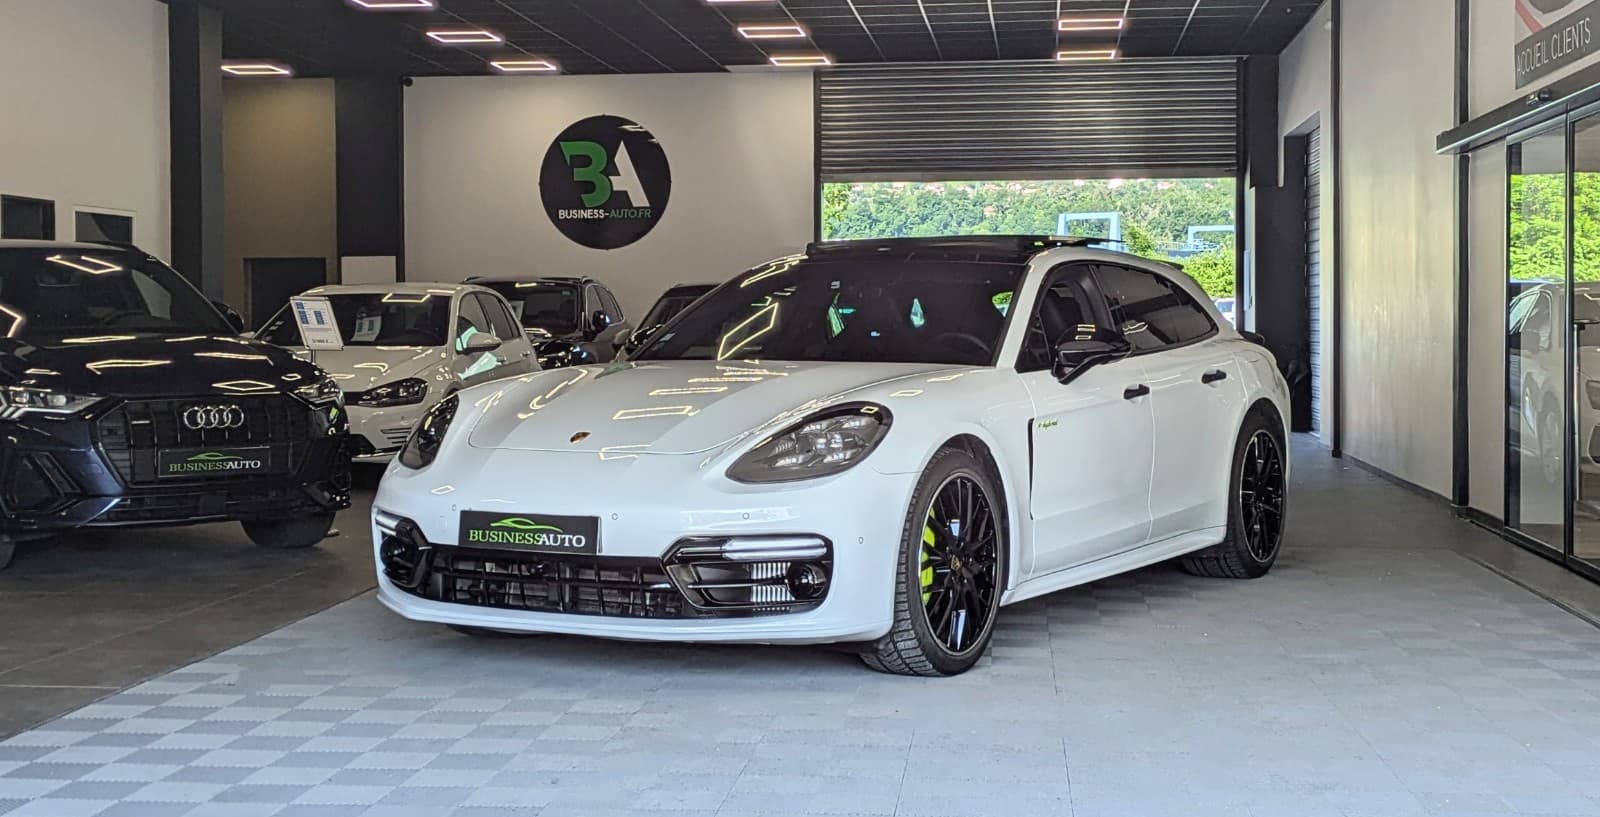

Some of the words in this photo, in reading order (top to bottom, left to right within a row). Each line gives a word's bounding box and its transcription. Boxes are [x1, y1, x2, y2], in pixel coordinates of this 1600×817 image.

[1516, 39, 1549, 79] ACCUEIL
[1551, 17, 1591, 60] CLIENTS
[559, 140, 651, 208] BA
[558, 208, 652, 219] BUSINESS-AUTO.FR
